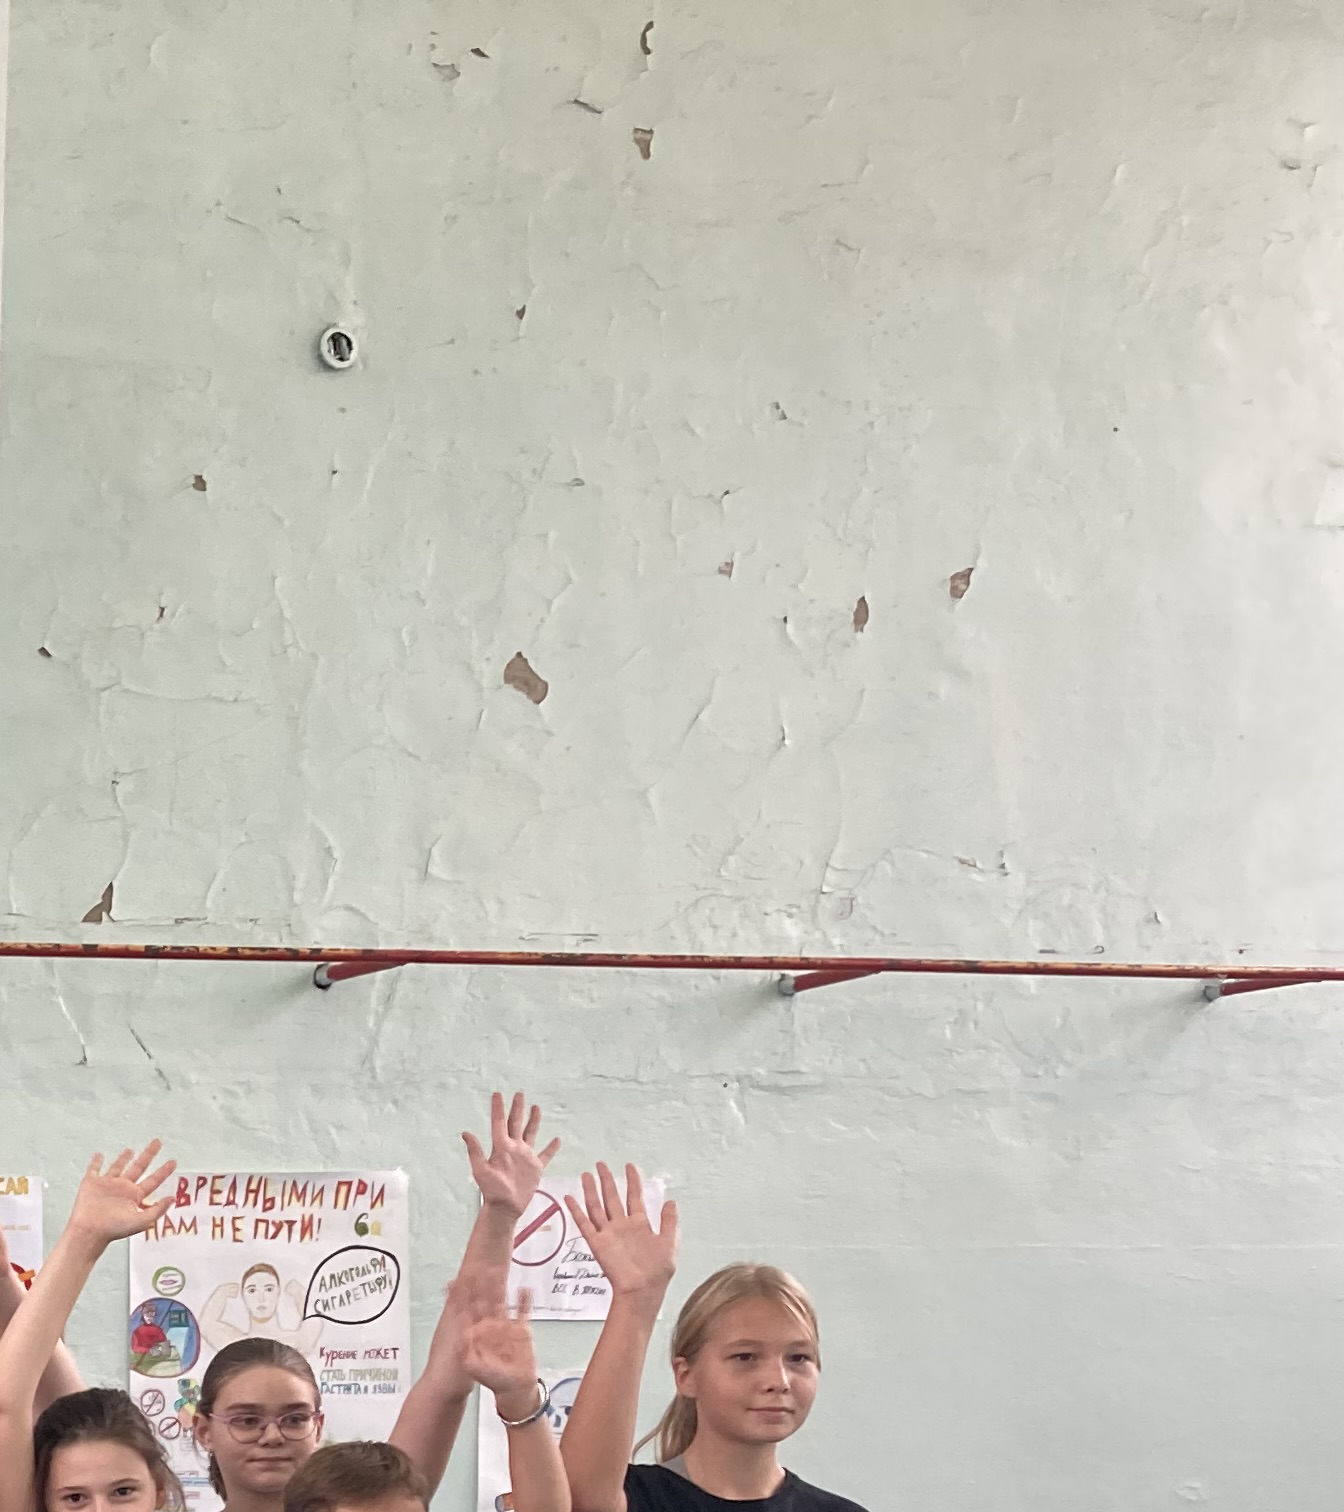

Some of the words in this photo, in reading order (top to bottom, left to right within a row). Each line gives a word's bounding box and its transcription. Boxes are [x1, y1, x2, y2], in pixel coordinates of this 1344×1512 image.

[175, 1174, 325, 1213] ВРЕДНЫМИ
[334, 1178, 385, 1210] ПРИ
[212, 1215, 246, 1243] НЕ
[253, 1213, 322, 1244] ПУТИ!
